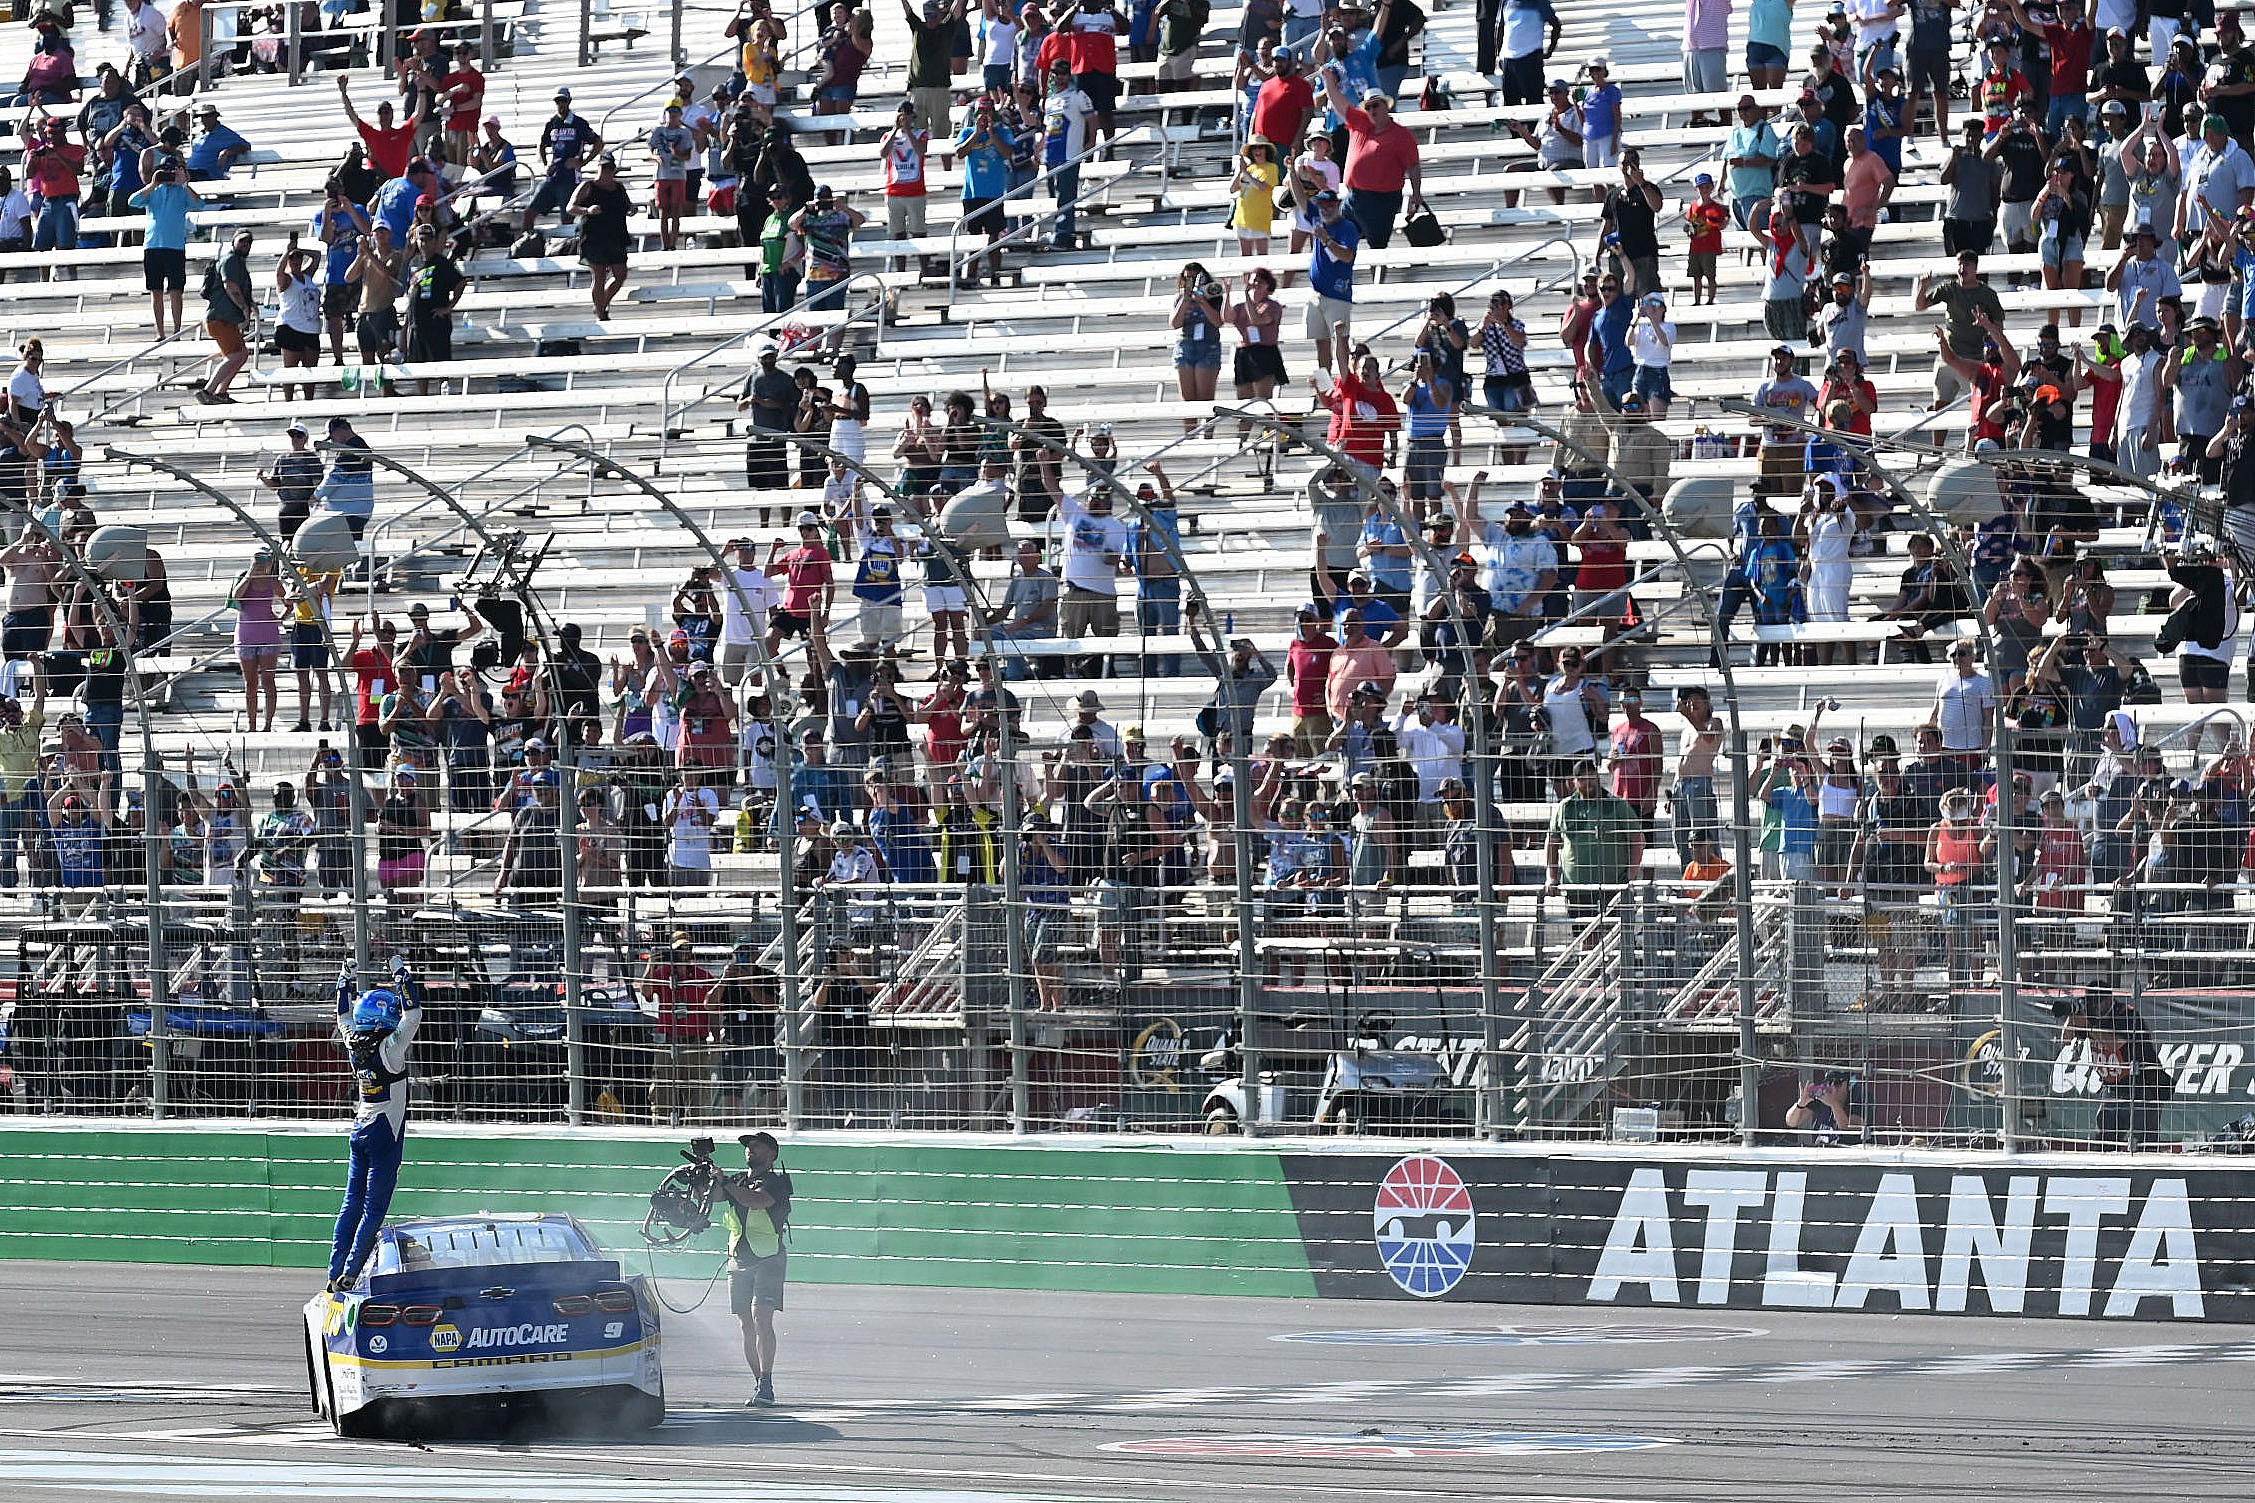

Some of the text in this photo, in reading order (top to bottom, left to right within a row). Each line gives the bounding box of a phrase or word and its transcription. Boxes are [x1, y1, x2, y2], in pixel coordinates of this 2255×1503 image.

[2052, 1037, 2244, 1094] QUKER
[1587, 1167, 2206, 1318] ATLANTA
[434, 1331, 459, 1347] NAPA
[603, 1322, 624, 1339] 9
[432, 1352, 572, 1369] CAMARO
